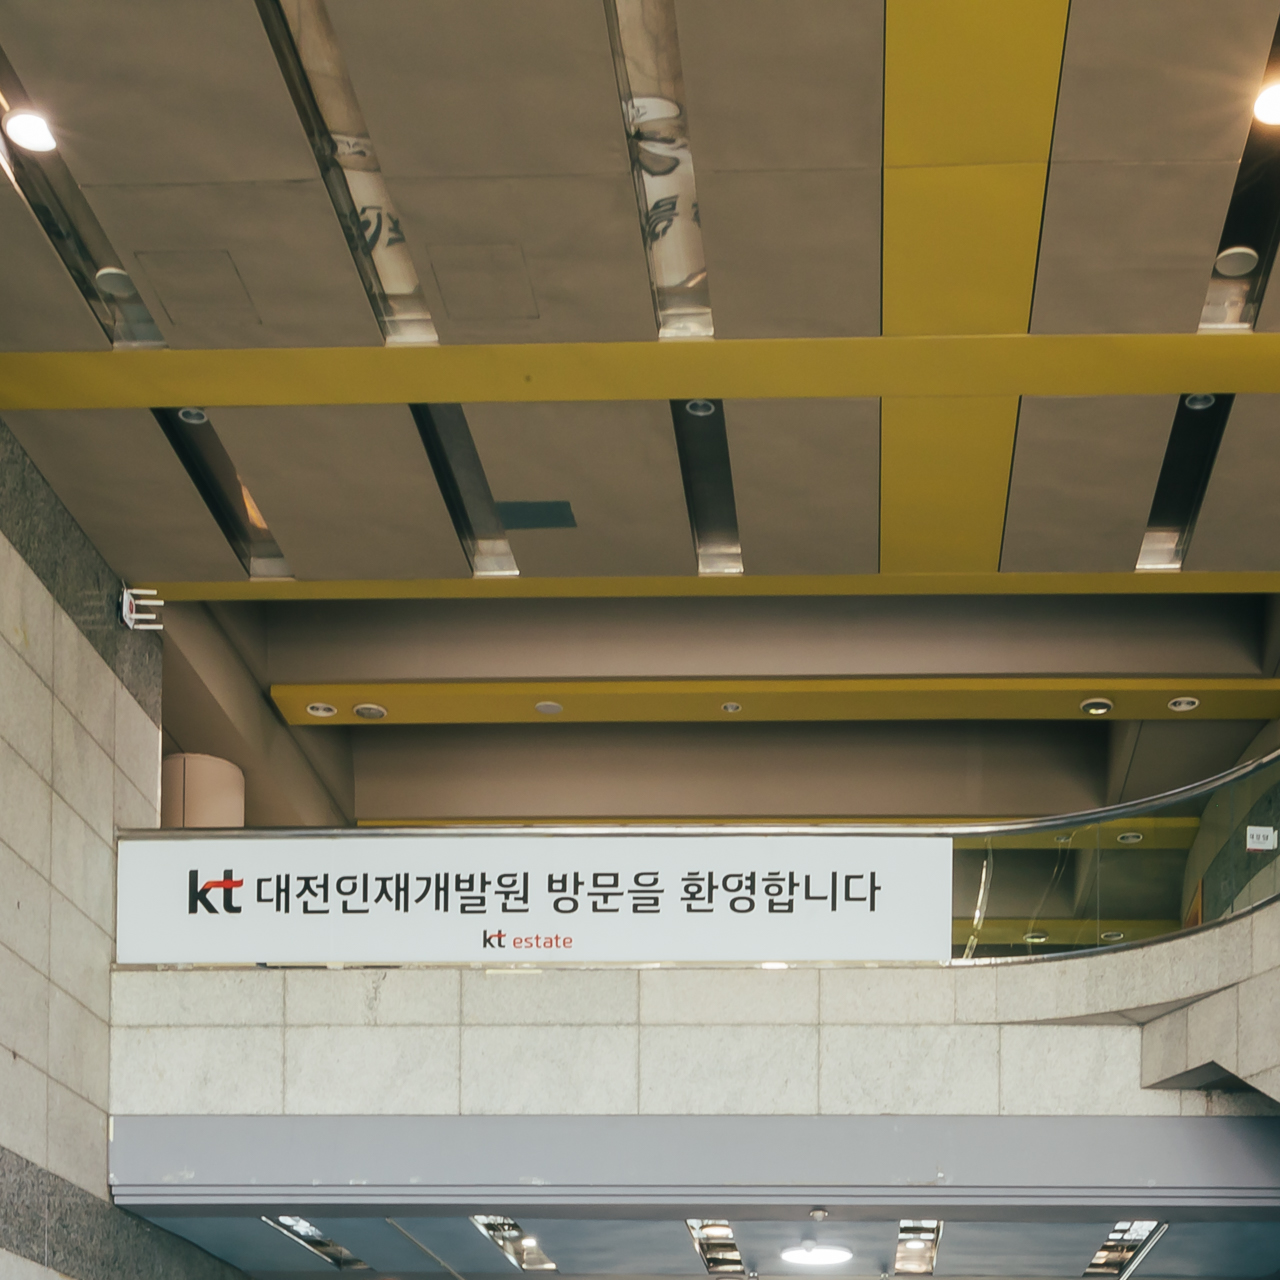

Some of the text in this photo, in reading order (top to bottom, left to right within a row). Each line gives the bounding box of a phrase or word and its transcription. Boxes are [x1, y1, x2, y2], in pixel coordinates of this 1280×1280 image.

[188, 869, 883, 915] kt 대전인재개발원 방문을 환영합니다
[482, 929, 574, 949] kt estate
